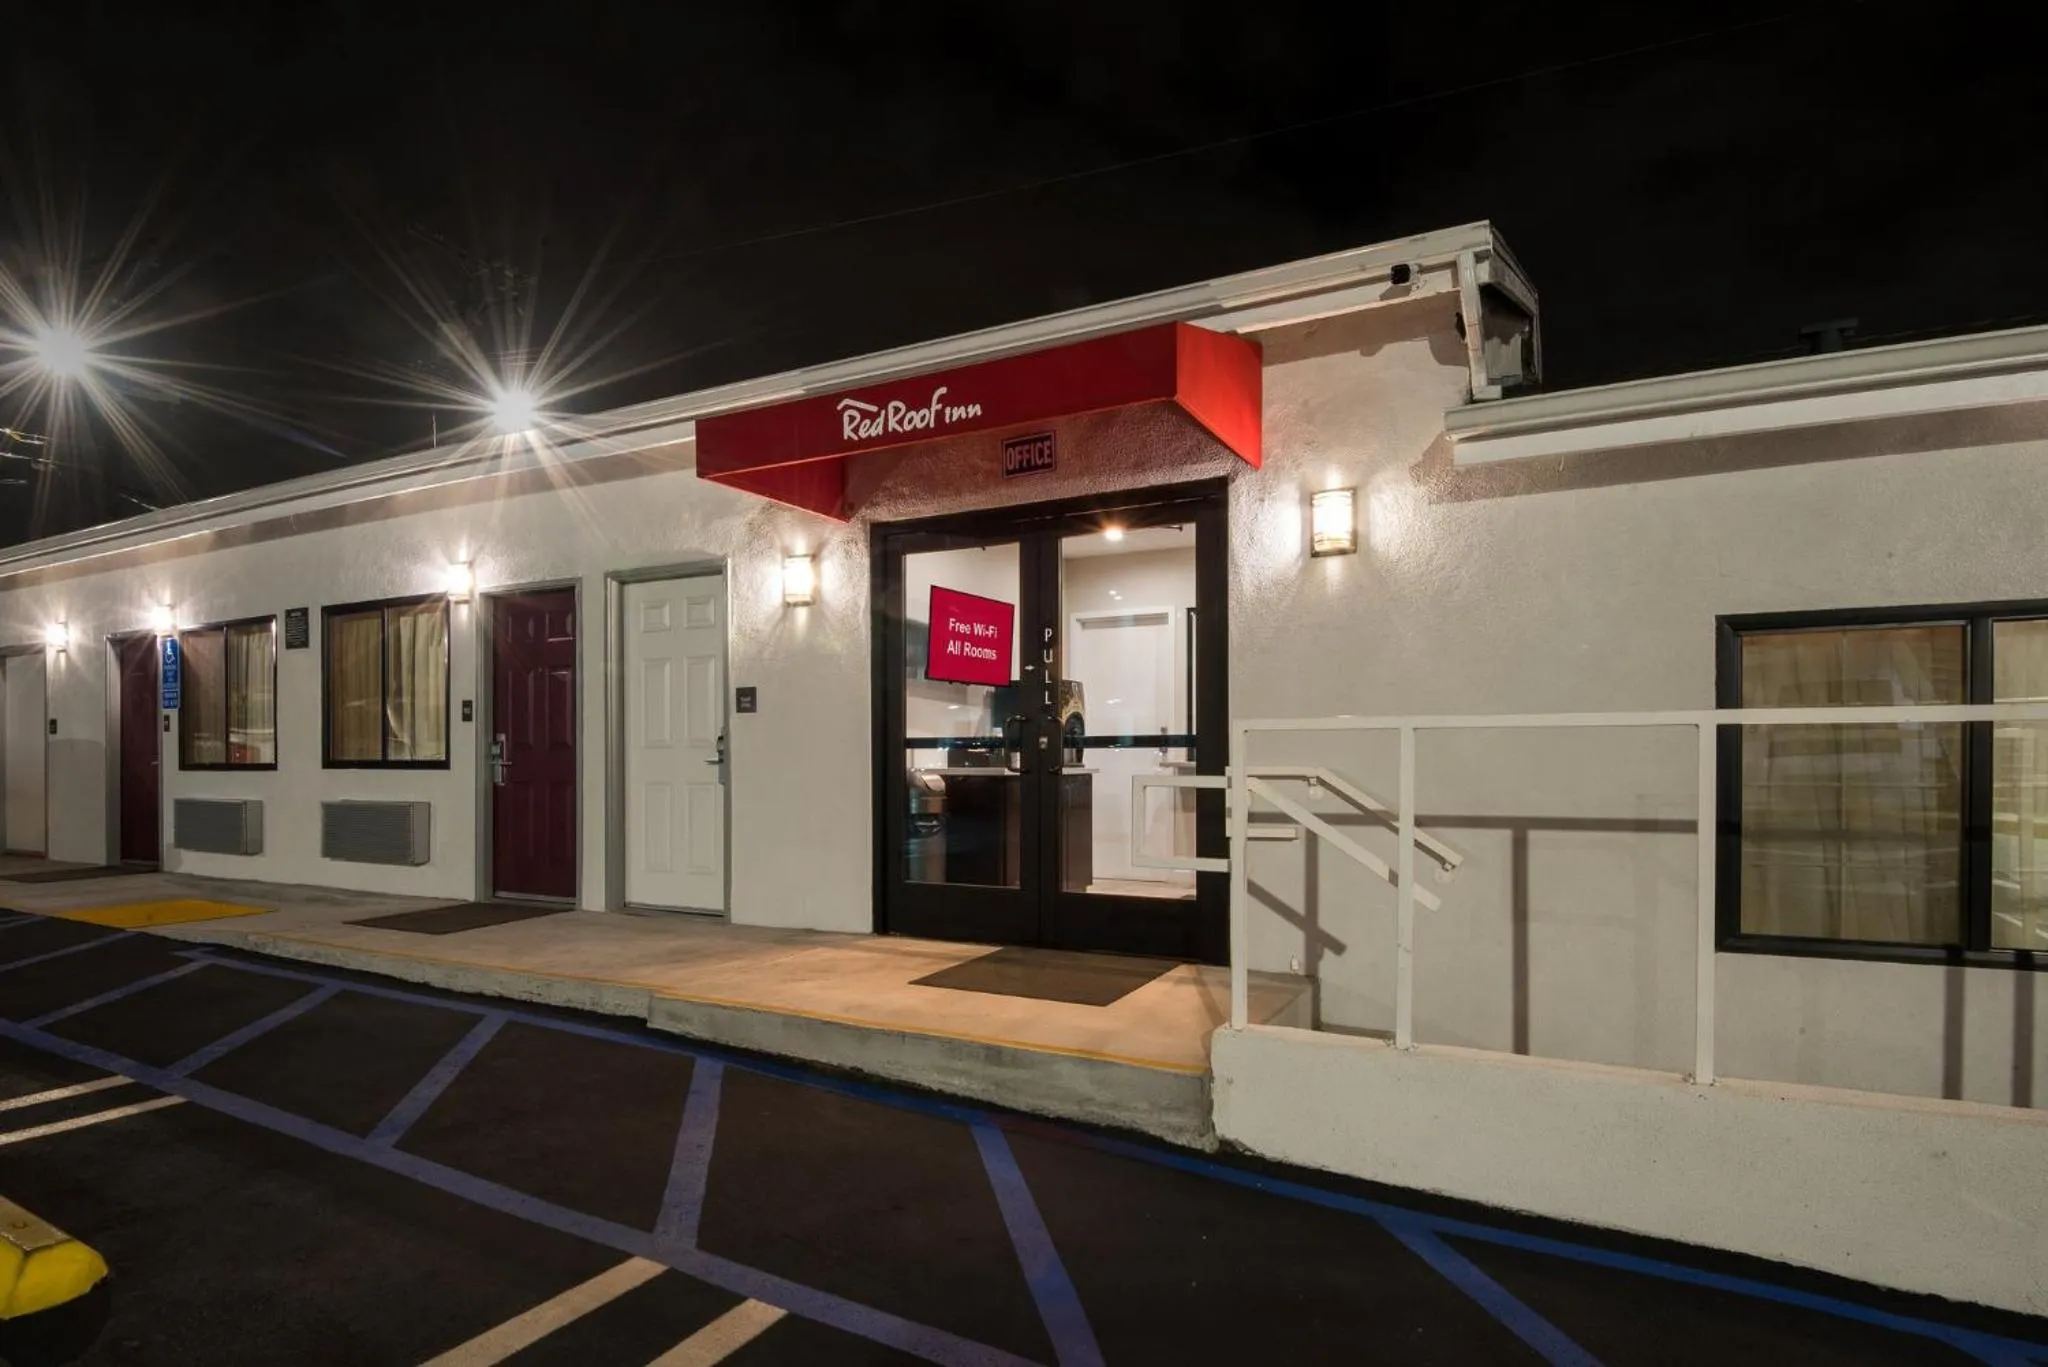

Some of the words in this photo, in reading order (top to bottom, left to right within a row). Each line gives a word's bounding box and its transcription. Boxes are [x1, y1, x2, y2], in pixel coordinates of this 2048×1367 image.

[843, 408, 885, 440] Red
[887, 387, 948, 433] Roof
[1006, 441, 1052, 470] OFFICE
[948, 618, 971, 635] Free
[973, 622, 997, 639] Wi-Fi
[947, 640, 961, 656] All
[963, 641, 997, 660] Rooms
[1043, 628, 1053, 704] PULL
